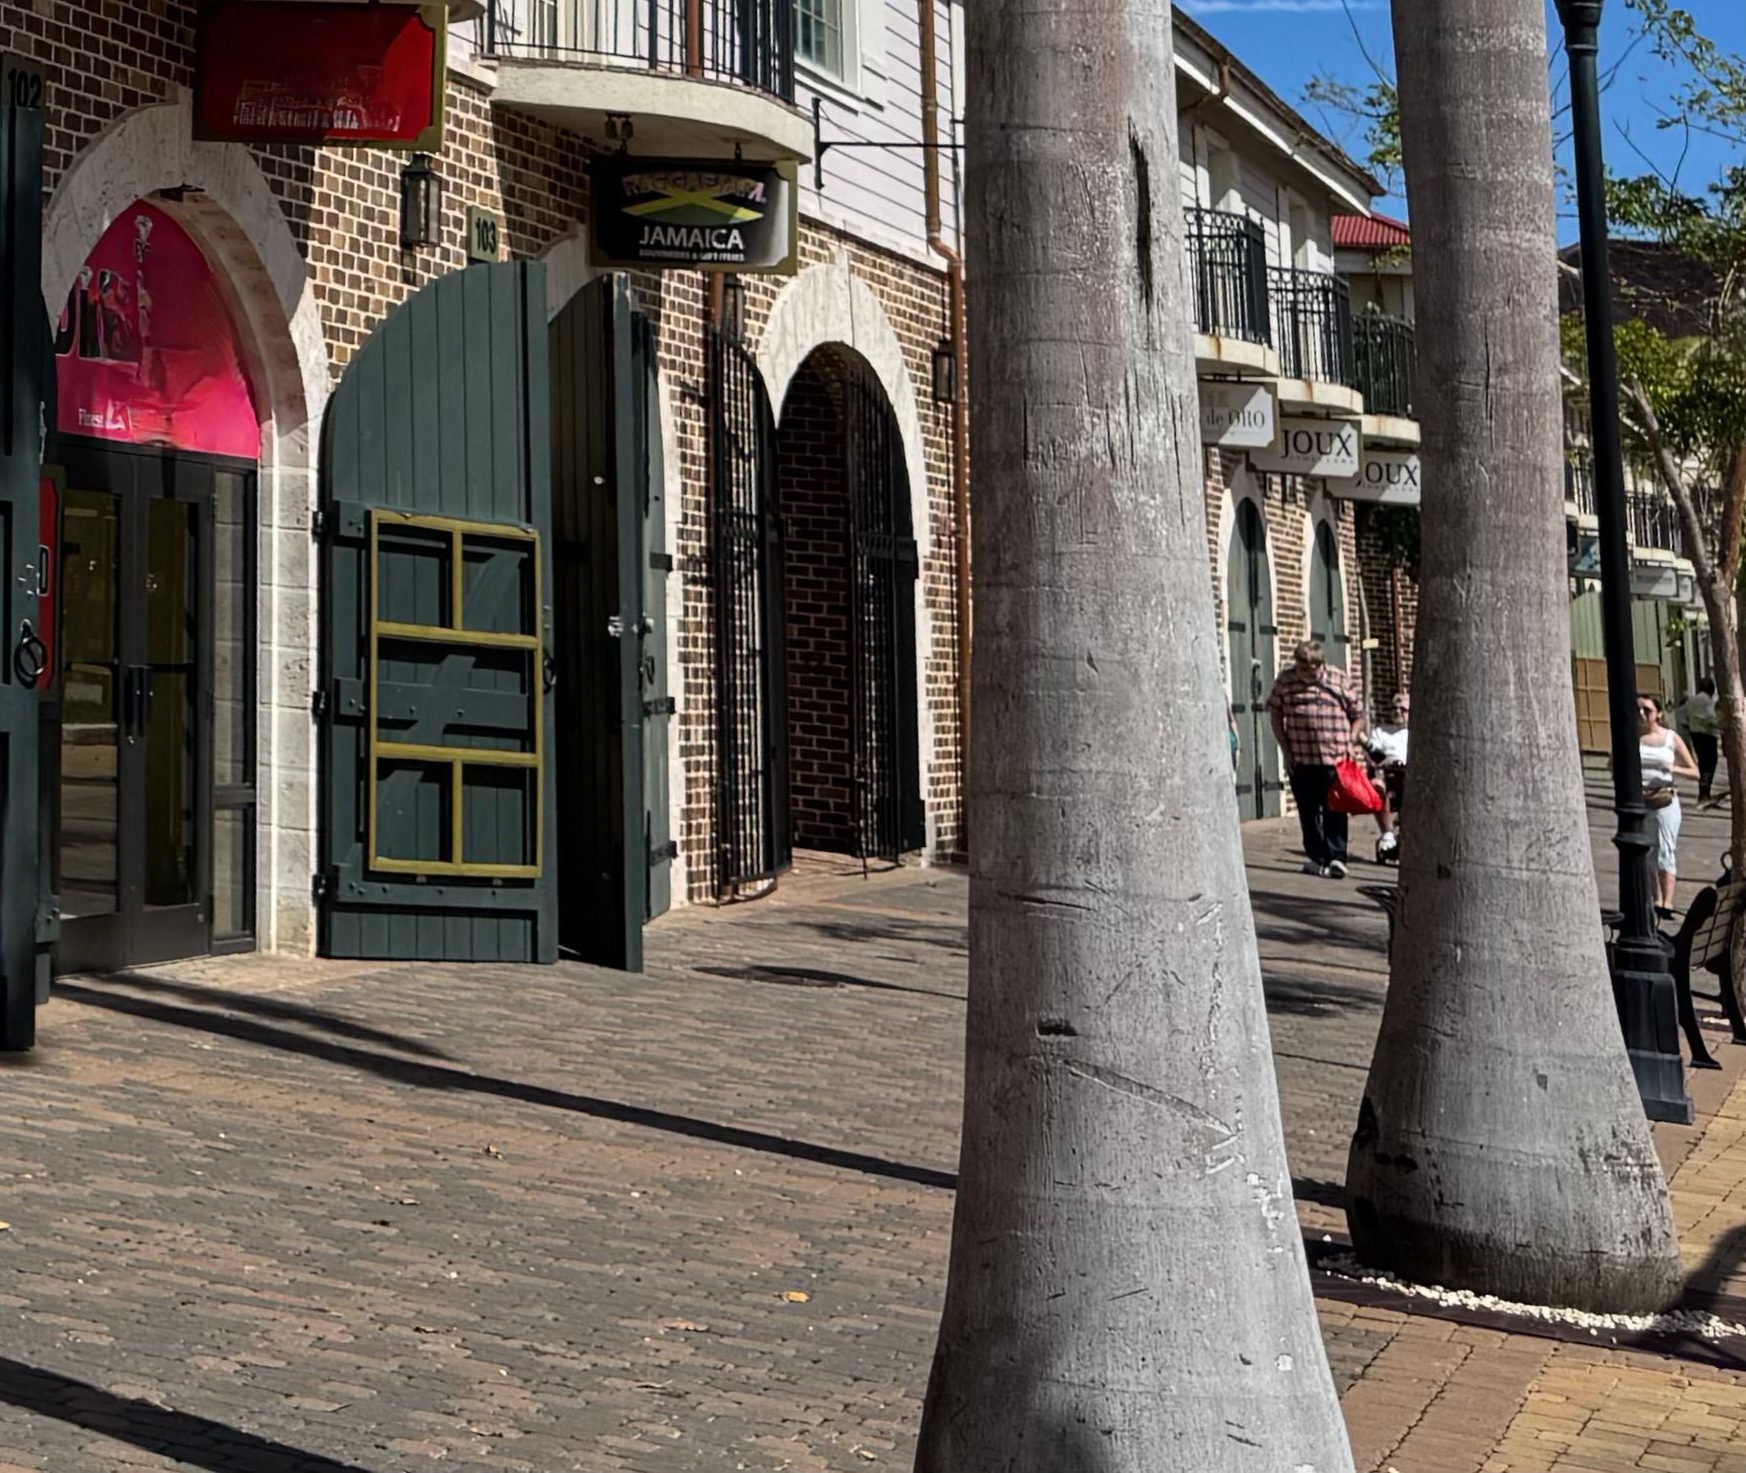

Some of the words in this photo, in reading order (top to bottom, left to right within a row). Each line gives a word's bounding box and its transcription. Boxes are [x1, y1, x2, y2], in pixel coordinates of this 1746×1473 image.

[475, 216, 497, 255] 103
[639, 225, 745, 250] JAMAICA
[1228, 408, 1266, 428] ORO
[1281, 429, 1353, 460] JOUX
[1356, 460, 1419, 487] OUX
